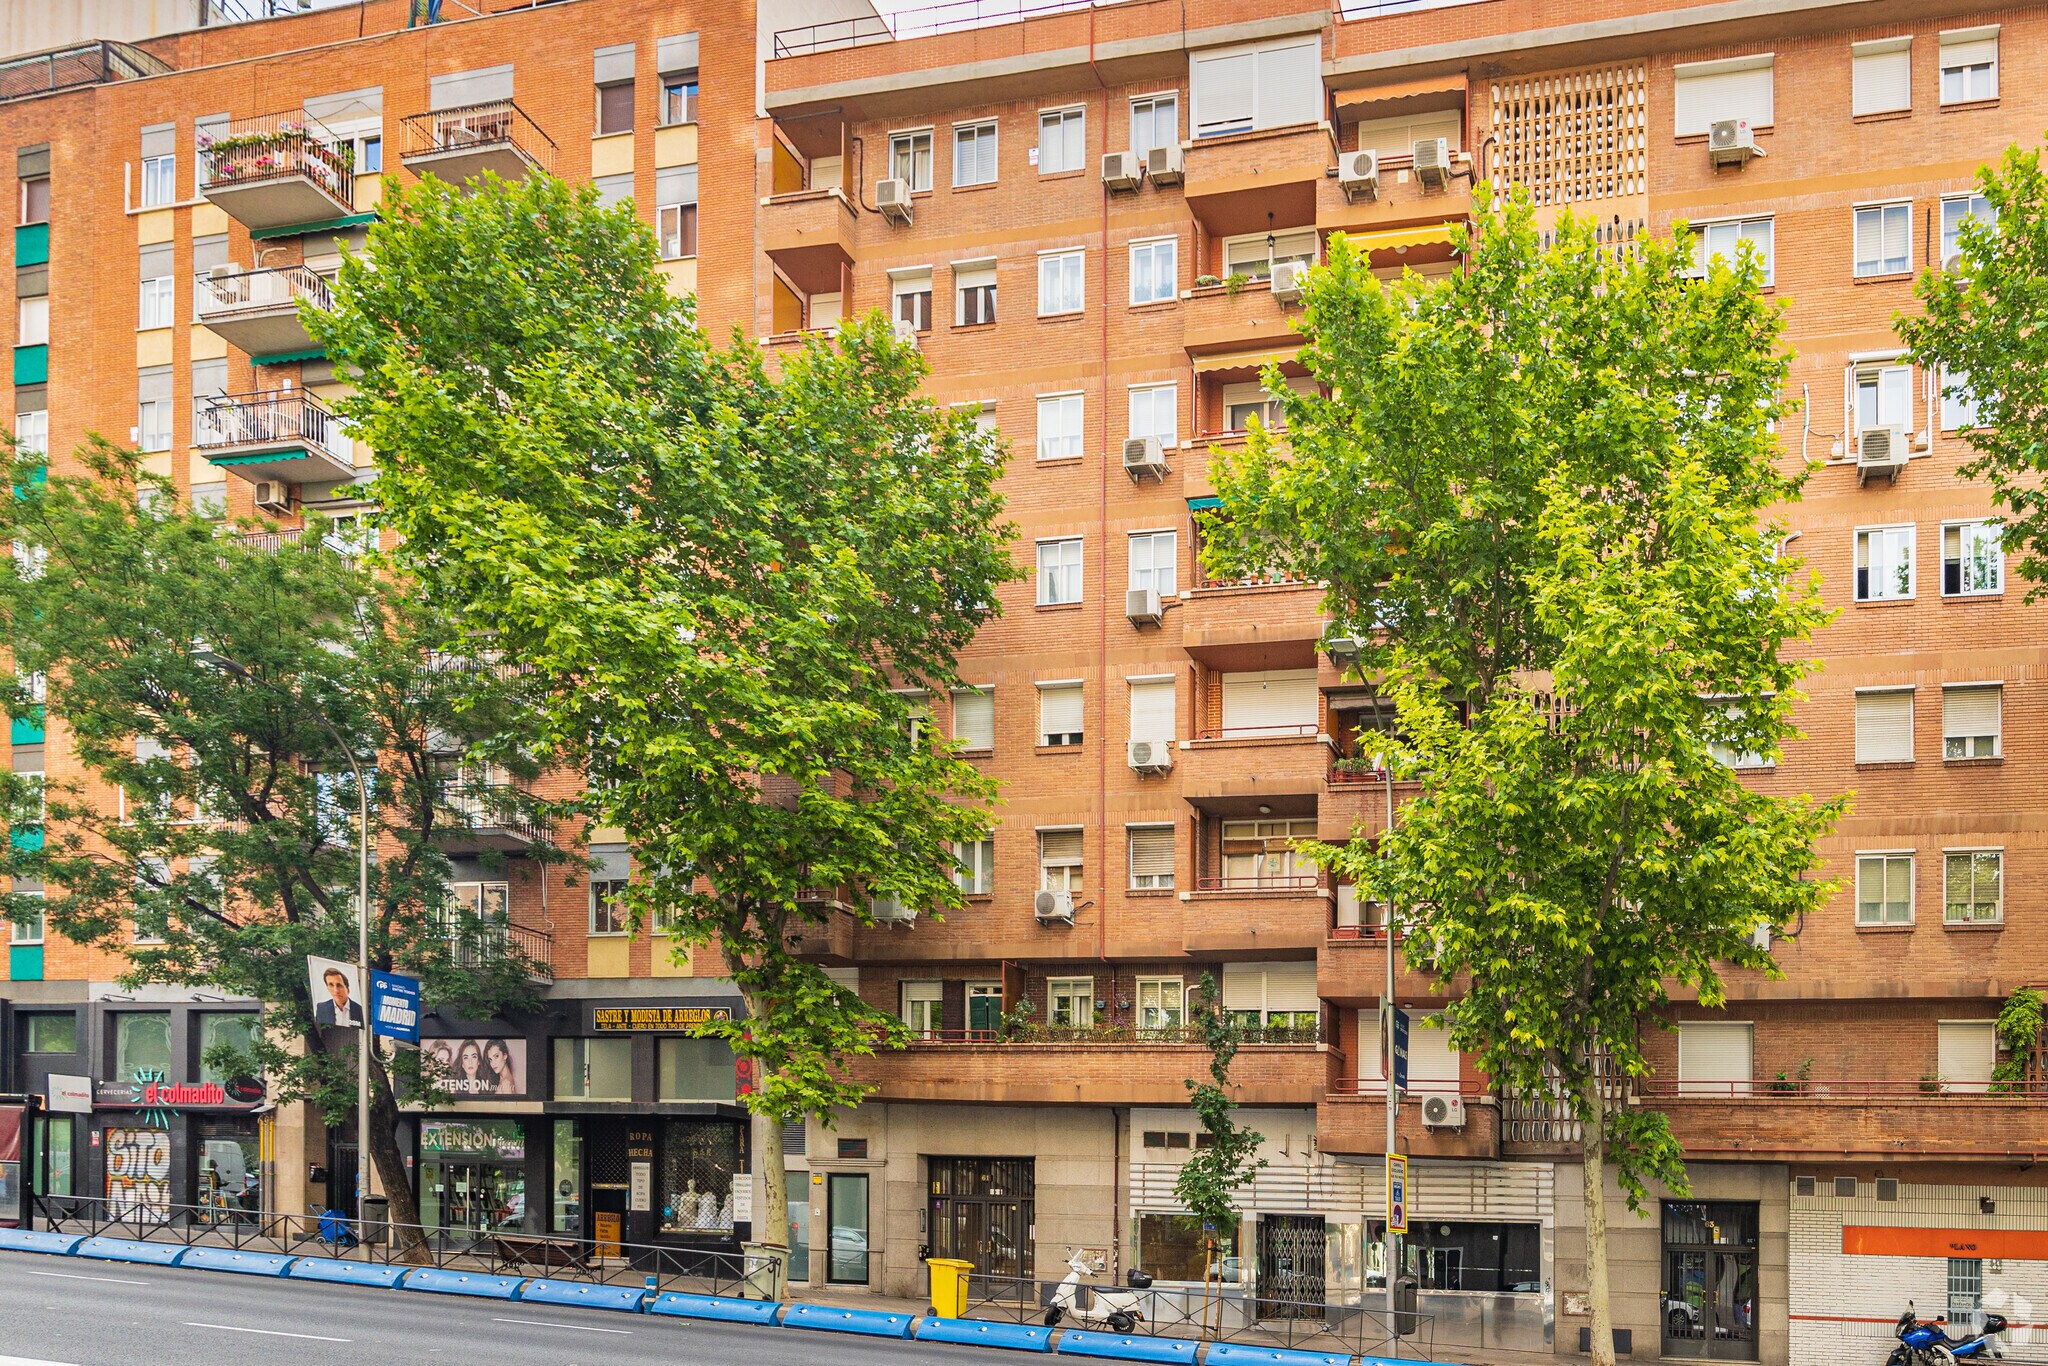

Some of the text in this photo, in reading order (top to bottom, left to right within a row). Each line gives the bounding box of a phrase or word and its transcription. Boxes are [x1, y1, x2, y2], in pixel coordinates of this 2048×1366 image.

[382, 995, 409, 1009] MOMENTO
[380, 1005, 417, 1027] MADRID
[596, 1010, 711, 1022] SASTRE Y MODISTA DE ARREGLOS
[145, 1082, 159, 1103] el
[161, 1082, 224, 1104] colmadito
[421, 1132, 493, 1147] EXTENSION
[629, 1132, 652, 1141] ROPA
[628, 1148, 653, 1157] HECHA
[1704, 1220, 1715, 1228] 63
